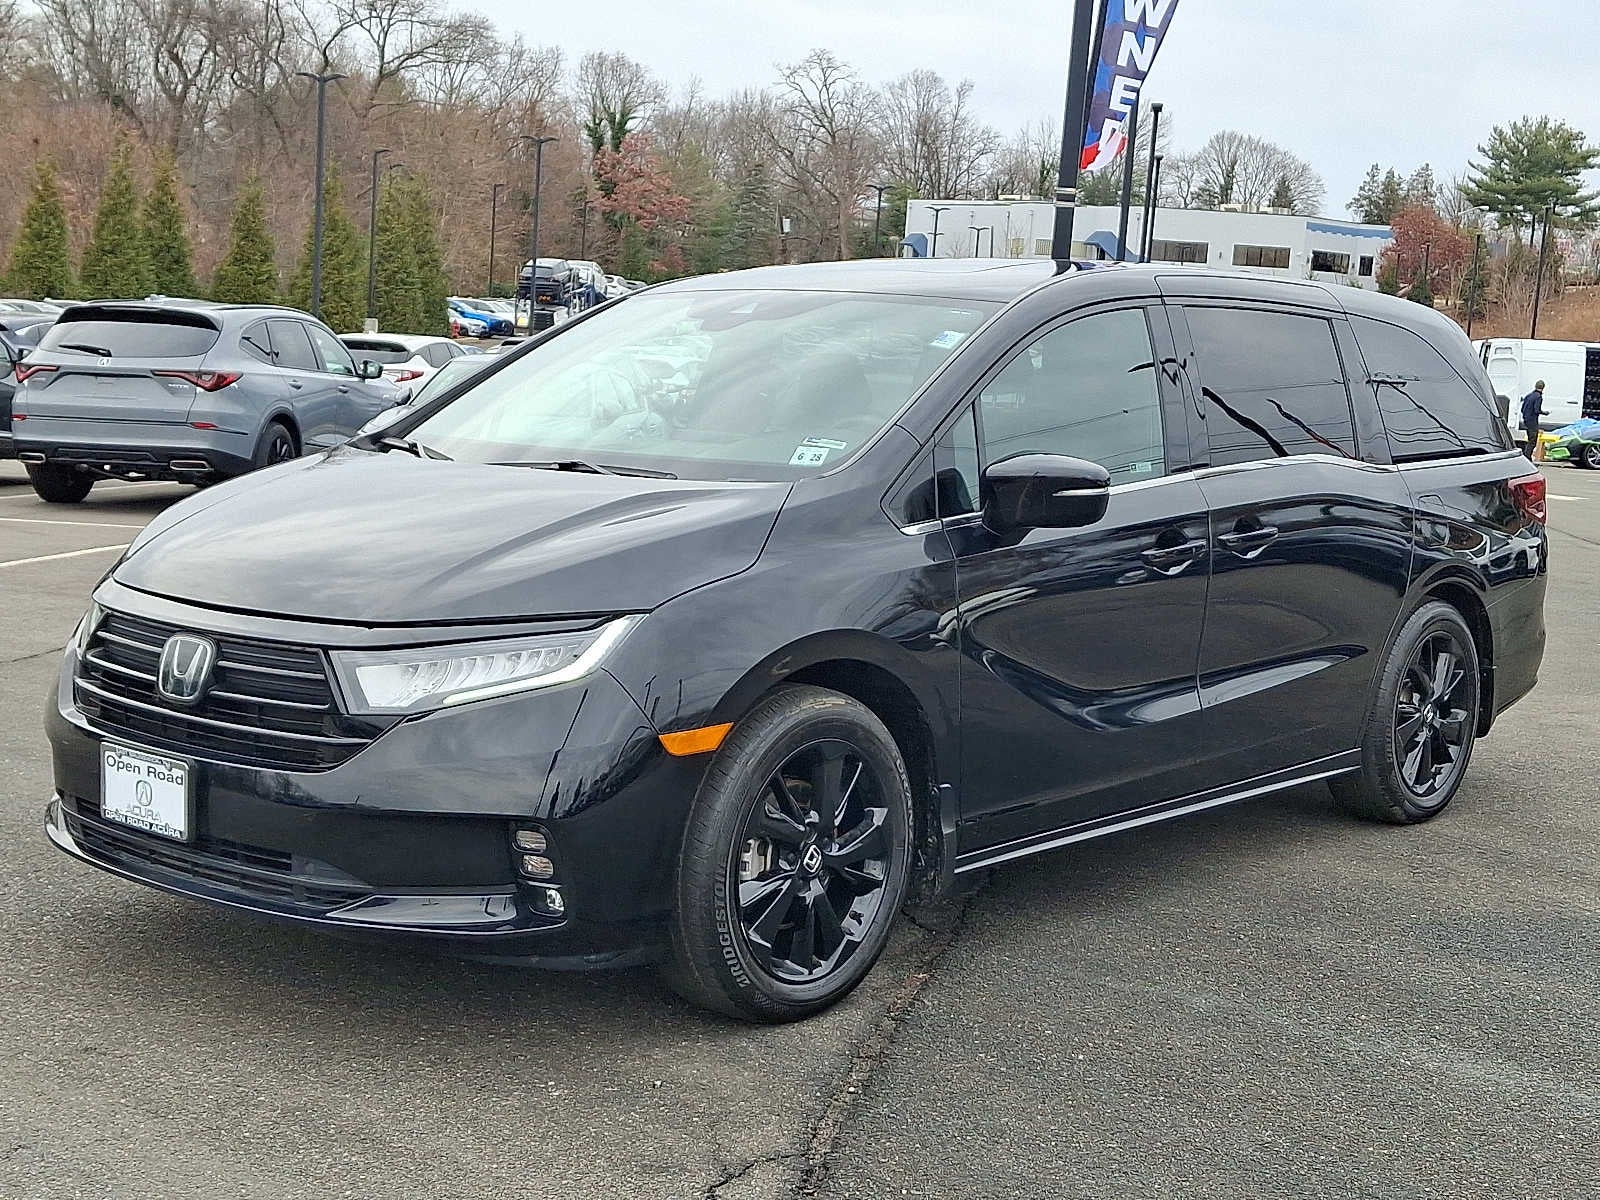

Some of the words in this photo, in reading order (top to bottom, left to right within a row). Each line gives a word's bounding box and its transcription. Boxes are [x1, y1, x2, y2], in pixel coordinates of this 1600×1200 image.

[106, 754, 141, 775] Open
[147, 765, 184, 786] Road
[127, 817, 151, 831] ROAD
